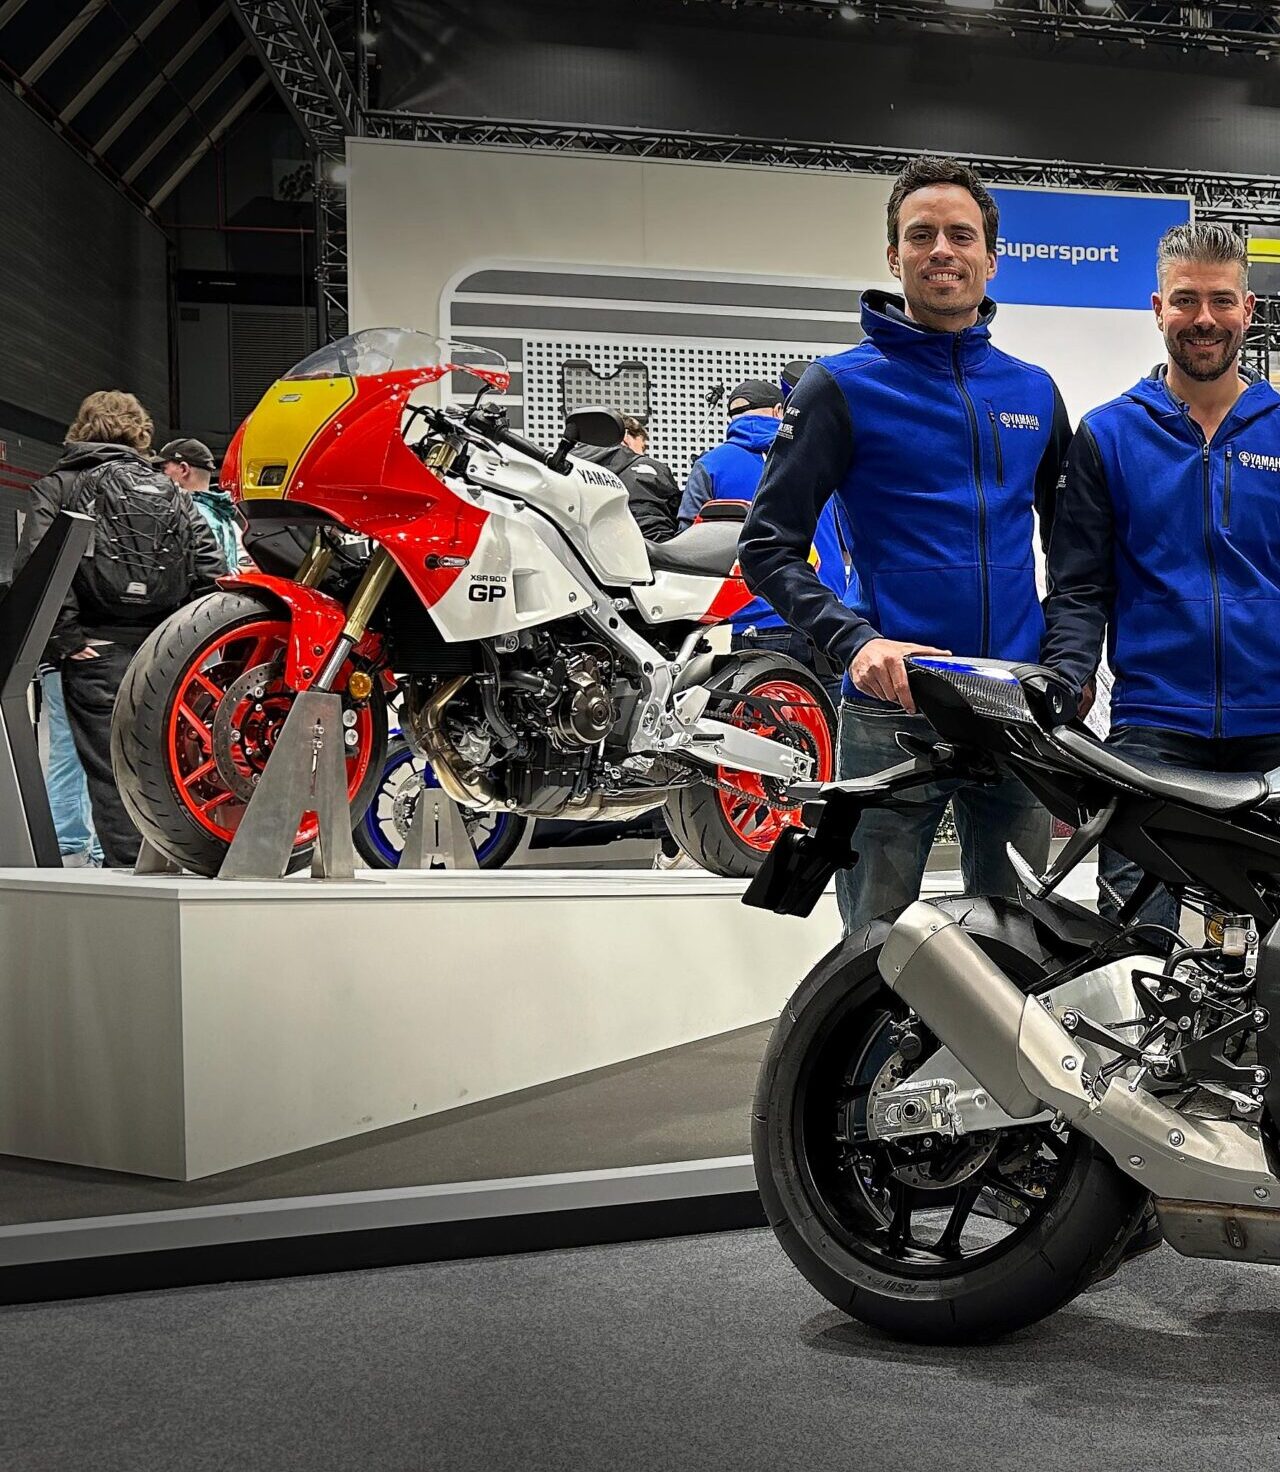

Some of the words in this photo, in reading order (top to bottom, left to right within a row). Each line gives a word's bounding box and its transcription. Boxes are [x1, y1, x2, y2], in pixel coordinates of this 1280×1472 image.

[995, 237, 1119, 265] Supersport
[1009, 413, 1040, 427] YAMAHA
[468, 584, 507, 603] GP
